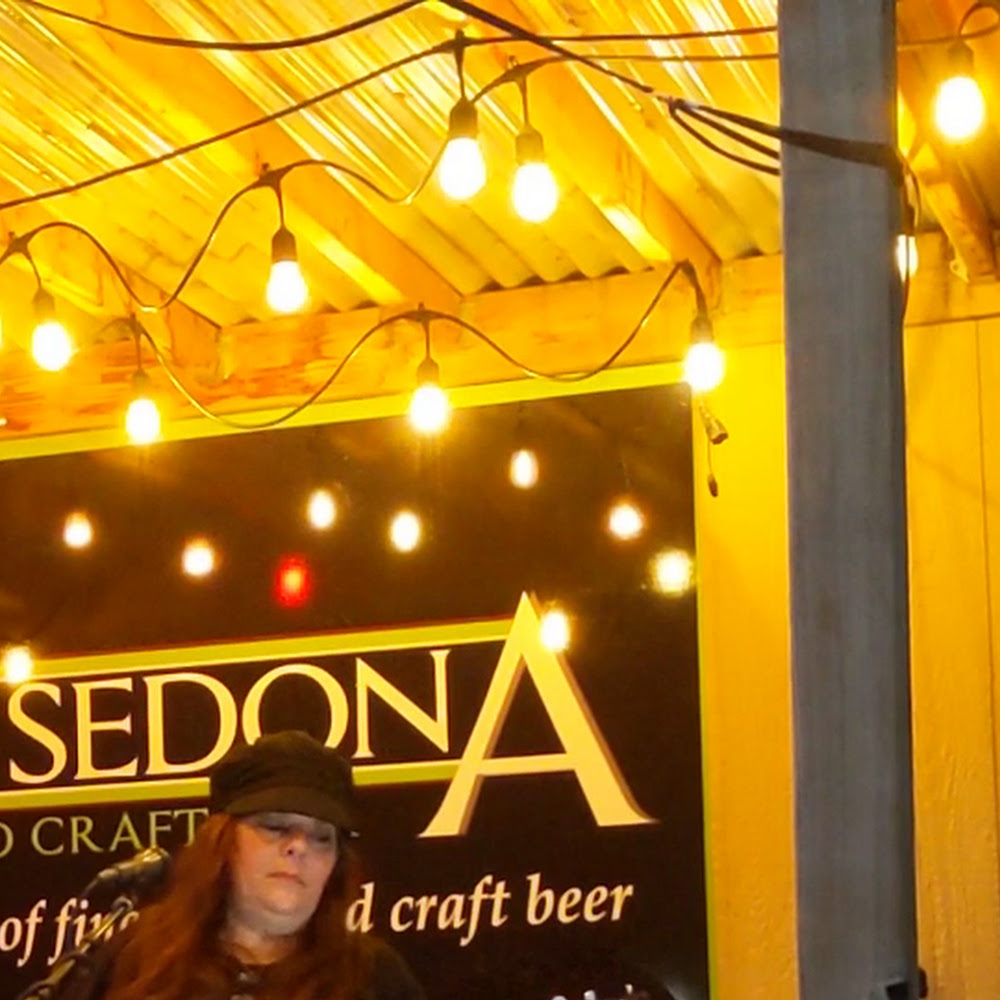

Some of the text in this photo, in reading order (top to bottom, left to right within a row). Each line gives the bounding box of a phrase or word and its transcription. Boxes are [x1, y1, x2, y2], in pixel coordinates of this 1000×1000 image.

[8, 590, 657, 838] SEDONA
[30, 808, 209, 856] CRAFT
[390, 874, 511, 947] craft
[526, 872, 634, 926] beer
